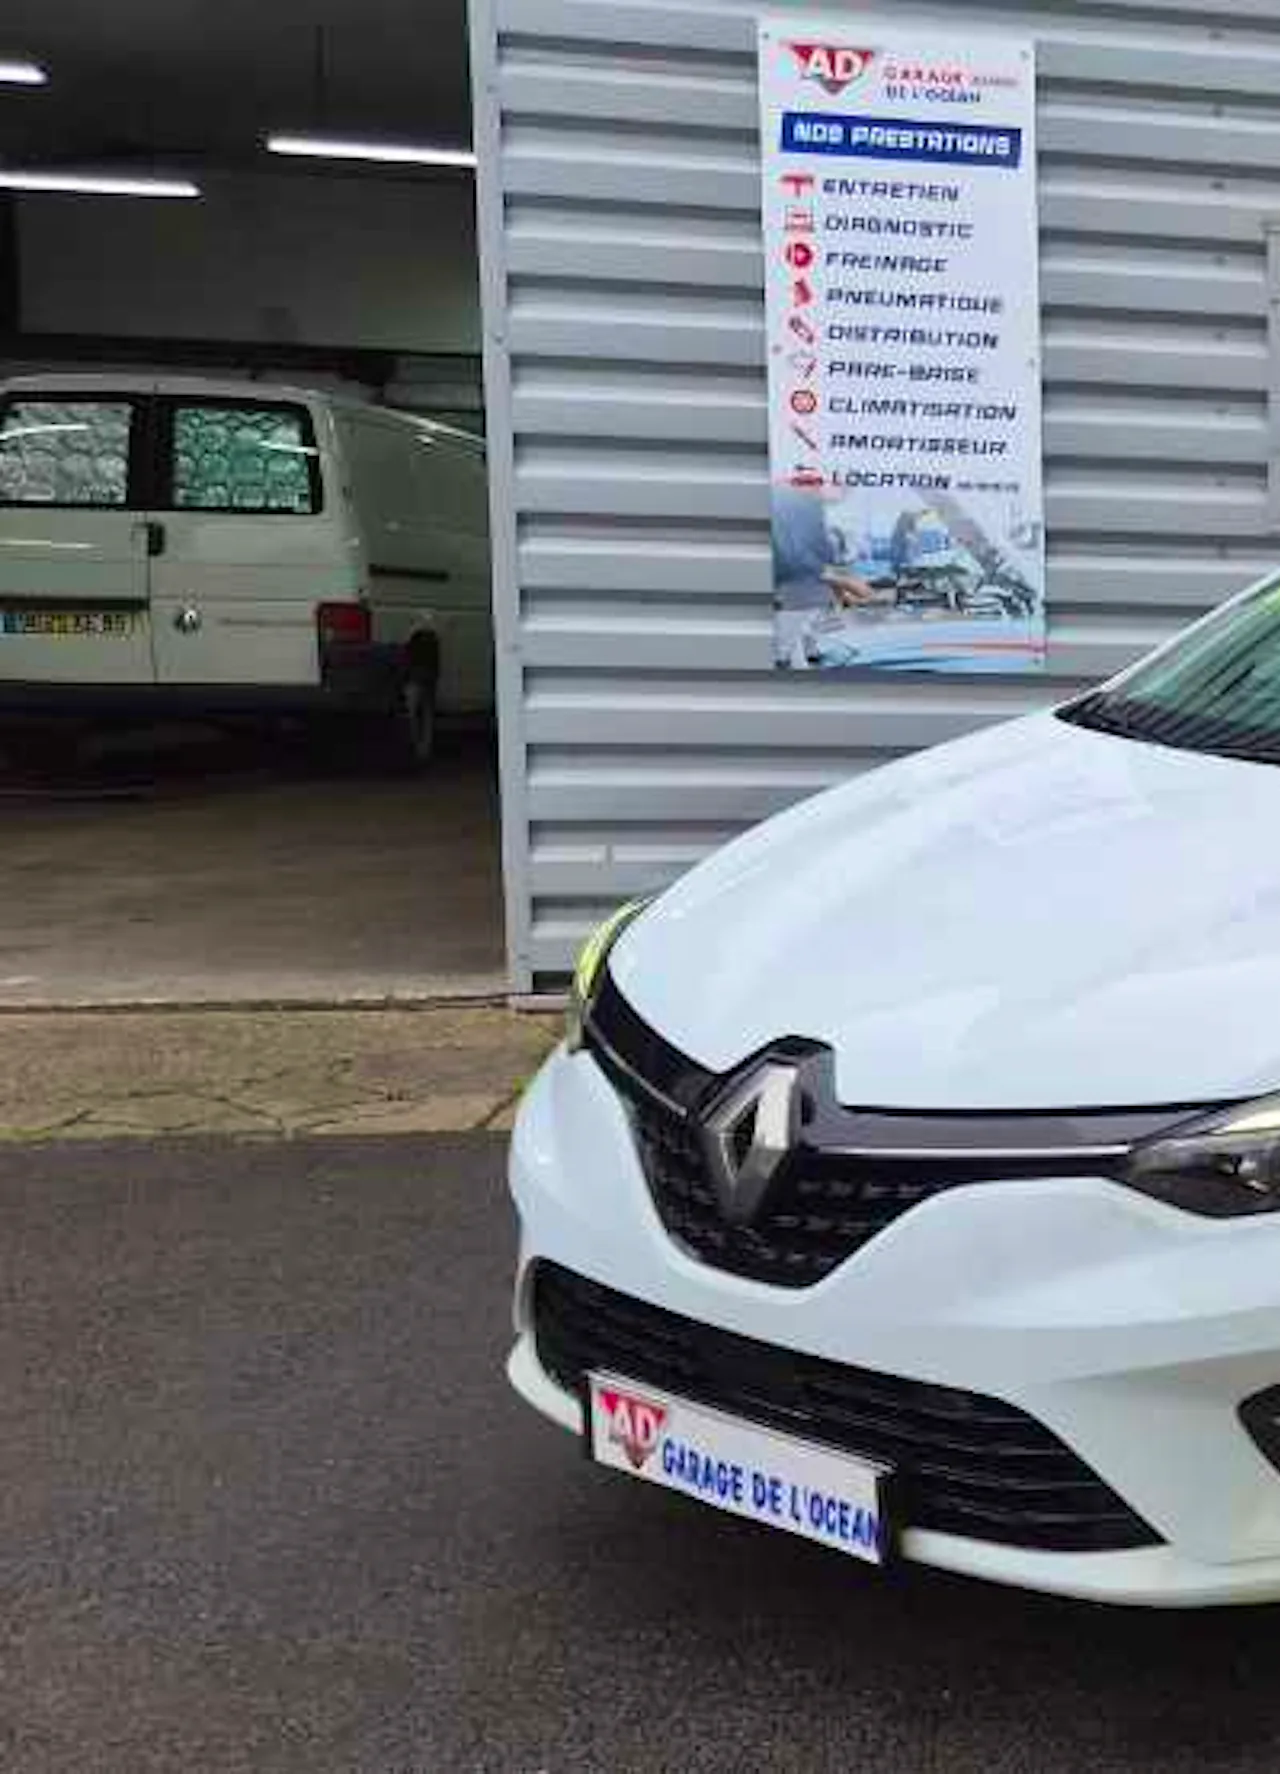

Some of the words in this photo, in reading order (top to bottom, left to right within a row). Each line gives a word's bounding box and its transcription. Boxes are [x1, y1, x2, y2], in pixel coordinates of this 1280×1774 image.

[803, 48, 864, 81] AD
[793, 122, 844, 143] NOS
[850, 126, 1011, 155] PRESTATIONS
[822, 179, 959, 202] ENTRETIEN
[824, 215, 974, 239] DIAGNOSTIC
[825, 252, 948, 273] FREINAGE
[827, 290, 1001, 314] PNEUMATIQUE
[828, 324, 998, 349] DISTRIBUTION
[828, 360, 982, 384] PARE-BRISE
[828, 398, 1016, 420] CLIMATISATION
[830, 434, 1006, 455] AMORTISSEUR
[832, 470, 949, 490] LOCATION
[612, 1404, 657, 1452] AD
[662, 1436, 744, 1503] GARAGE
[752, 1473, 783, 1515] DE
[791, 1485, 879, 1549] L'OCEAN
